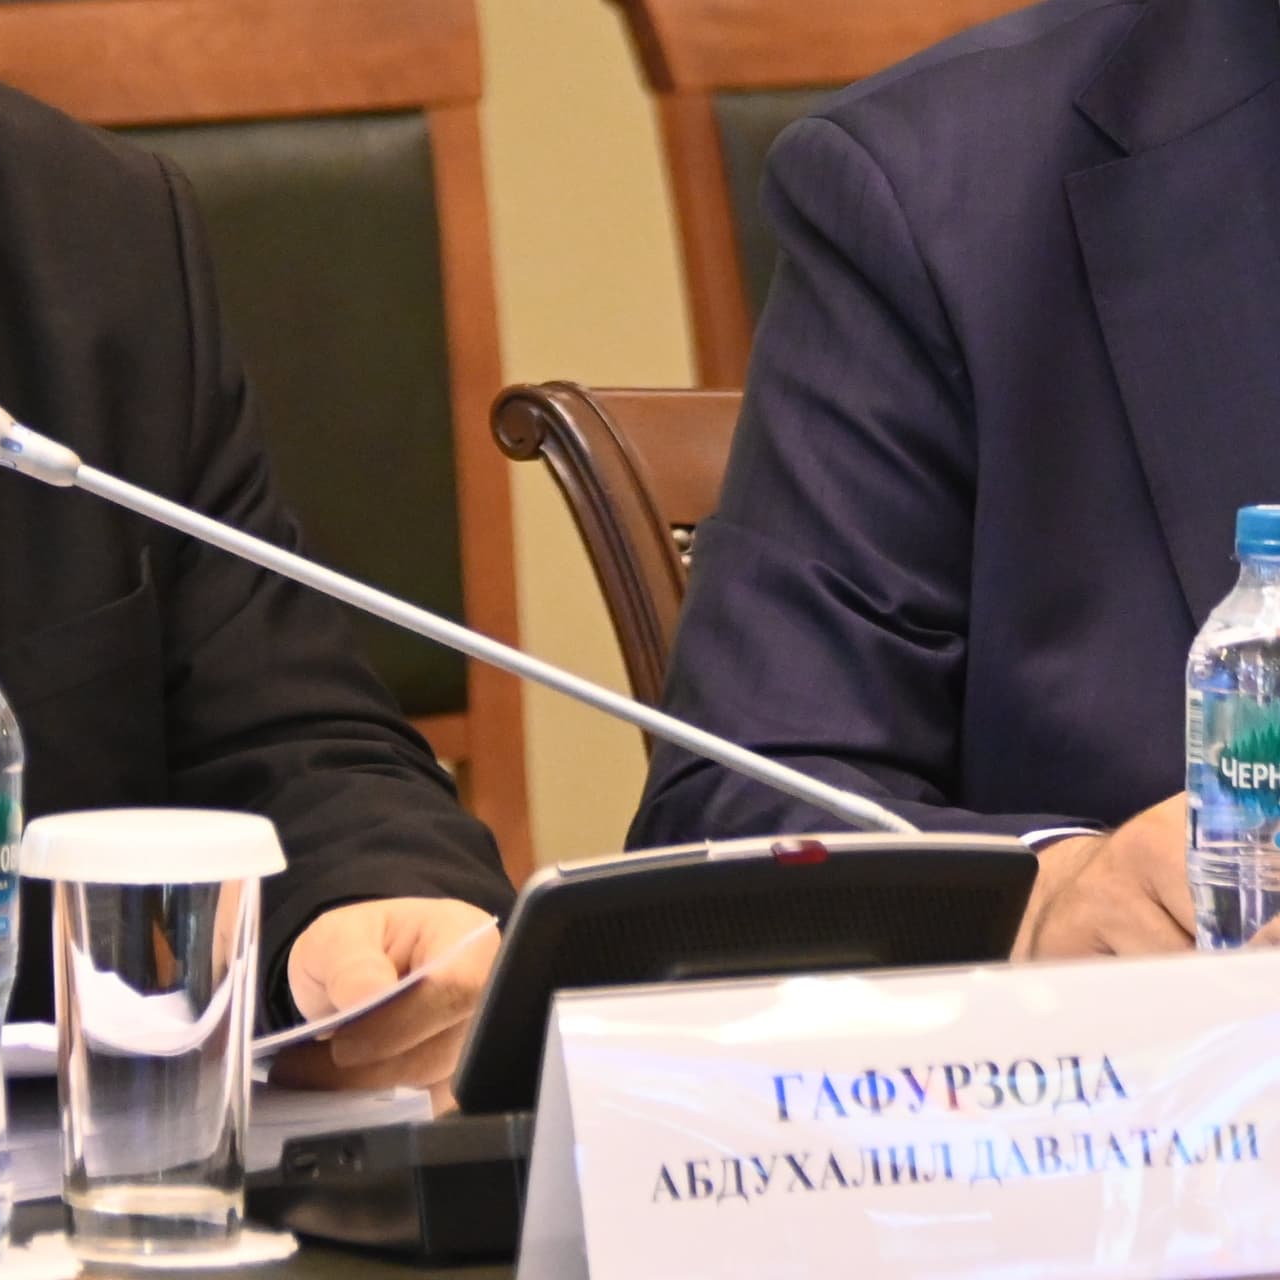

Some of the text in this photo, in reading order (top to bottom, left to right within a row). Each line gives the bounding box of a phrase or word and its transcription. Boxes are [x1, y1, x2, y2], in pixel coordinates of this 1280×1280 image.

[771, 1053, 1128, 1121] ГАФУРЗОДА
[652, 1123, 1261, 1206] АБДУХАЛИЛ ДАВЛАТАЛИ
